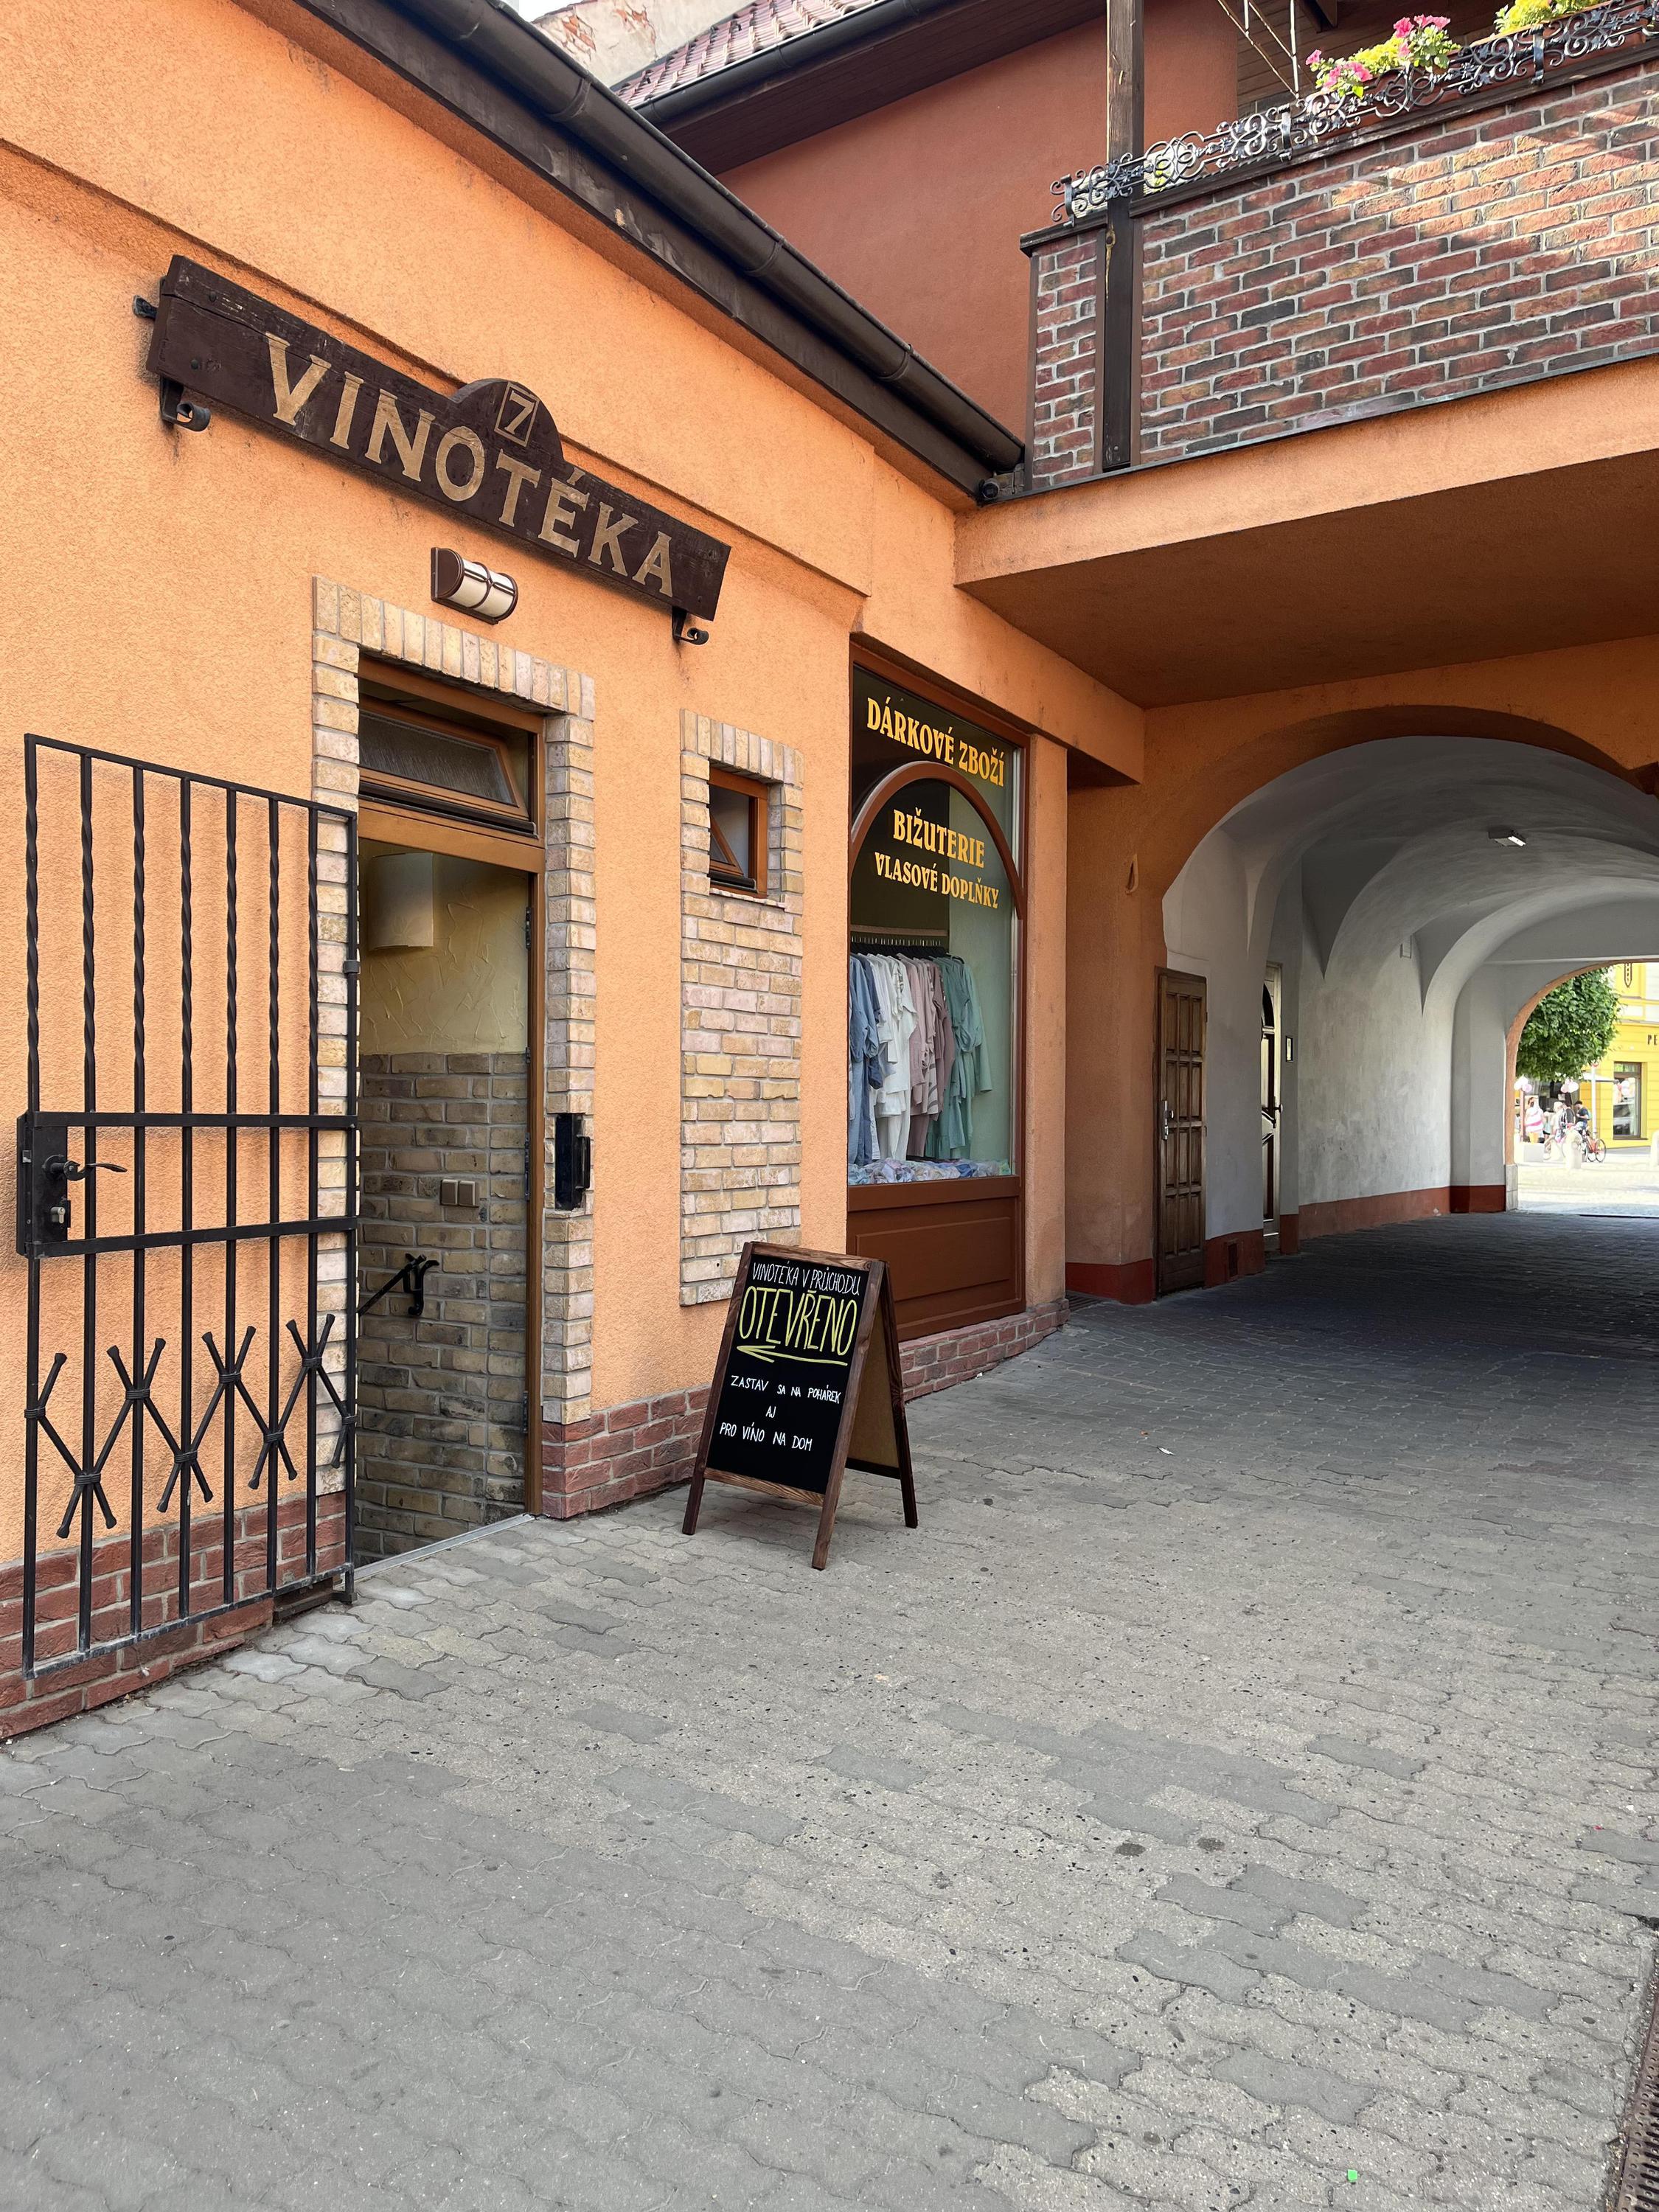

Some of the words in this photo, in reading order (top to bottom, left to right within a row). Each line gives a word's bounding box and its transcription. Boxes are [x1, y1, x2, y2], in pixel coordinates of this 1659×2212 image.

[505, 393, 535, 436] 7
[265, 331, 674, 598] VINOTÉKA
[867, 696, 954, 765] DÁRKOVÉ
[959, 740, 1005, 787] ZBOŽÍ
[893, 807, 984, 868] BIŽUTERIE
[874, 852, 938, 892] VLASOVÉ
[942, 873, 999, 909] DOPLŇKY
[752, 1261, 799, 1286] VINOTÉKA
[802, 1269, 810, 1288] V
[810, 1267, 861, 1295] PRŮCHODU
[739, 1286, 858, 1355] OTEVŘENO
[731, 1375, 769, 1391] ZASTAV
[776, 1384, 786, 1395] SA
[790, 1386, 801, 1397] NA
[807, 1385, 842, 1404] POHÁREK
[765, 1405, 776, 1418] AJ
[719, 1422, 737, 1437] PRO
[742, 1422, 765, 1442] VÍNO
[772, 1431, 786, 1446] NA
[791, 1436, 813, 1452] DOM
